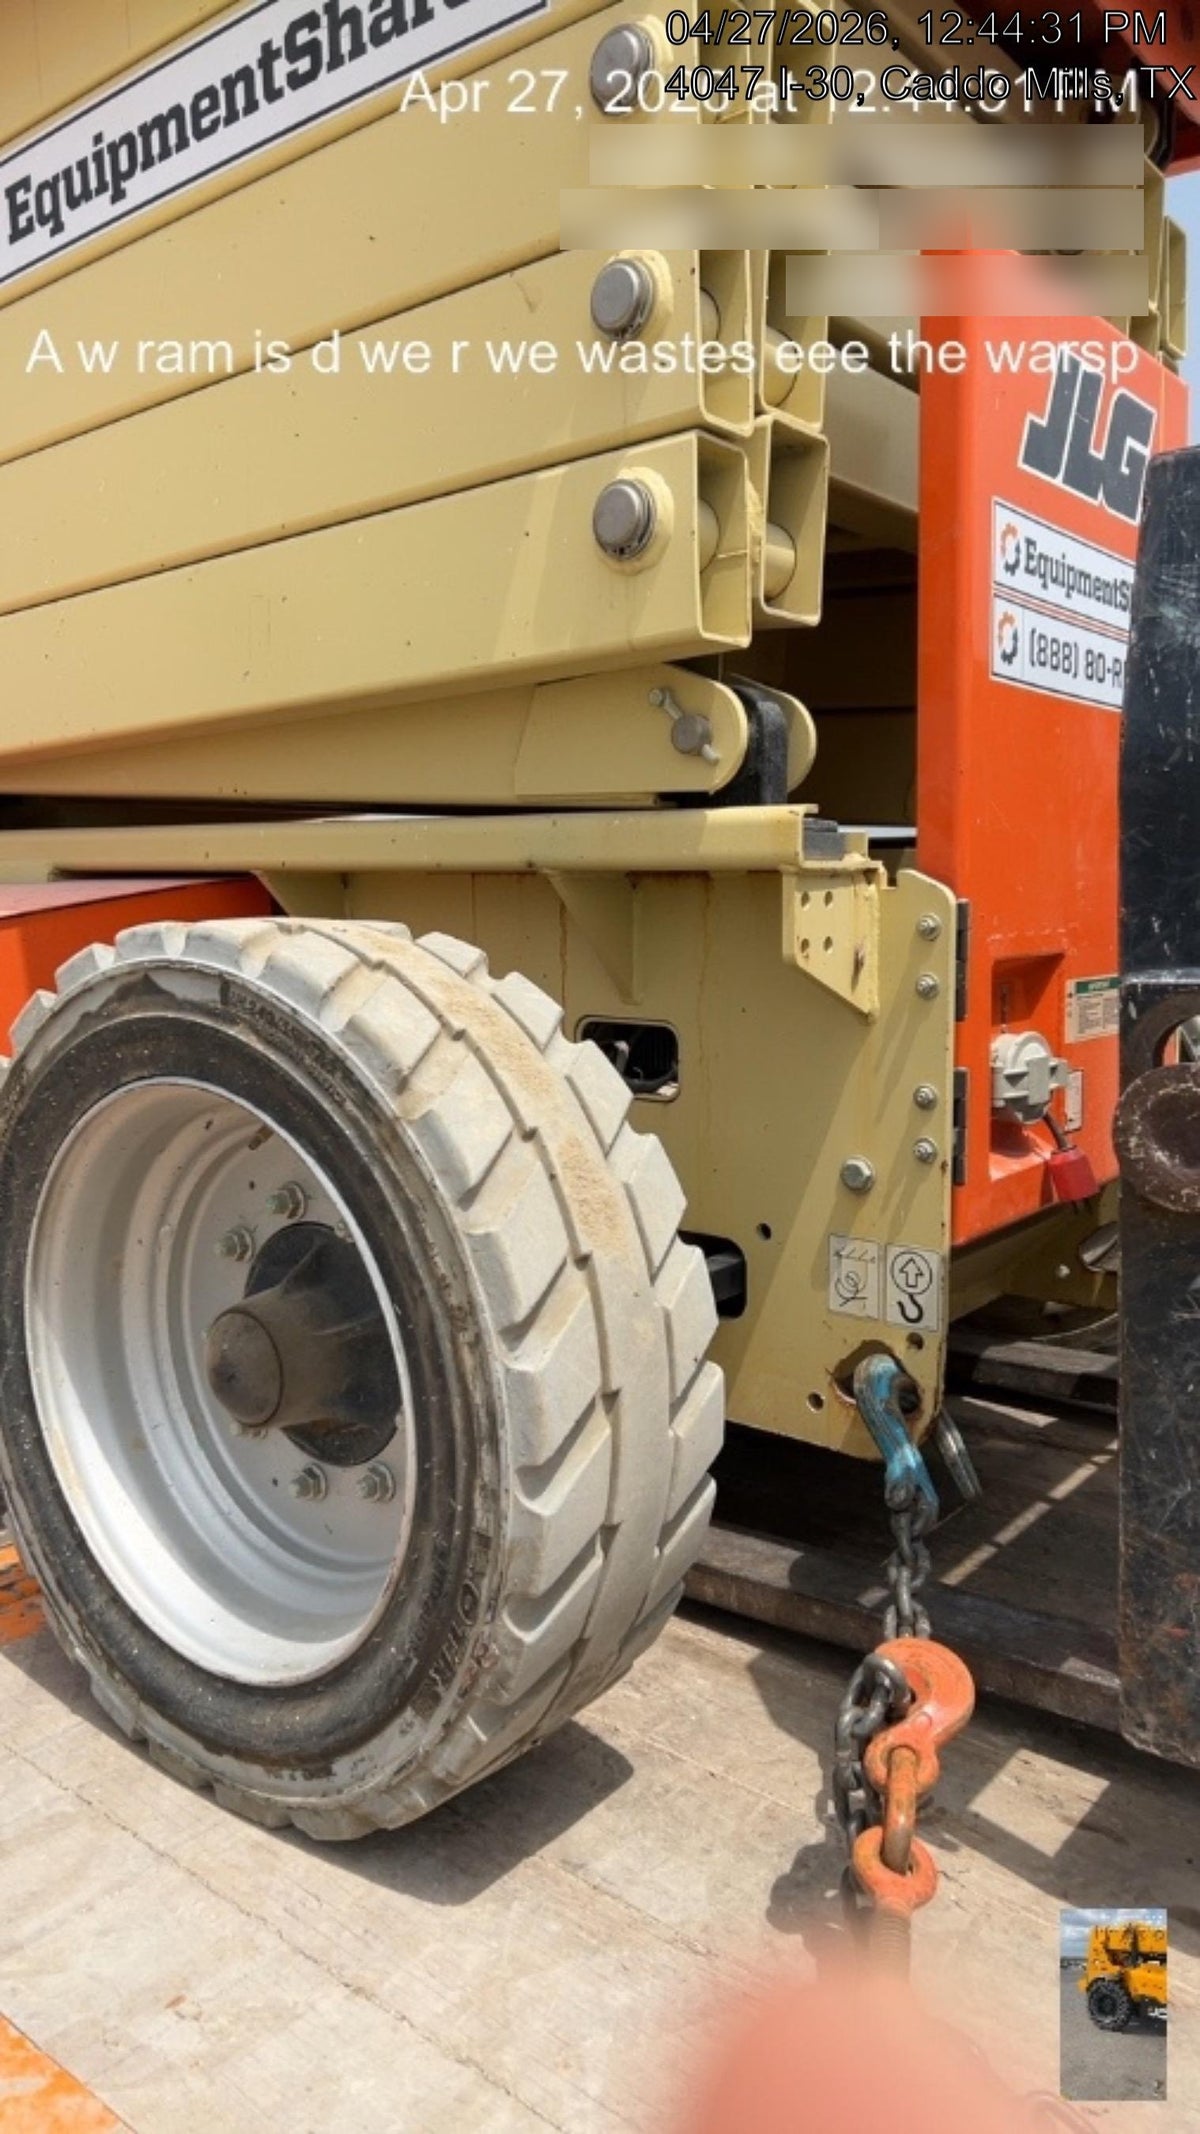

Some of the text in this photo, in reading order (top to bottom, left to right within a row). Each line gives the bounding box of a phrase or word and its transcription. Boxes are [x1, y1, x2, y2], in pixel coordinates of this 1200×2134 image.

[4, 0, 472, 245] EquipmentShar
[1018, 346, 1157, 526] JLG
[1024, 536, 1134, 613] EquipmentS
[1029, 627, 1125, 689] (888) 80-R
